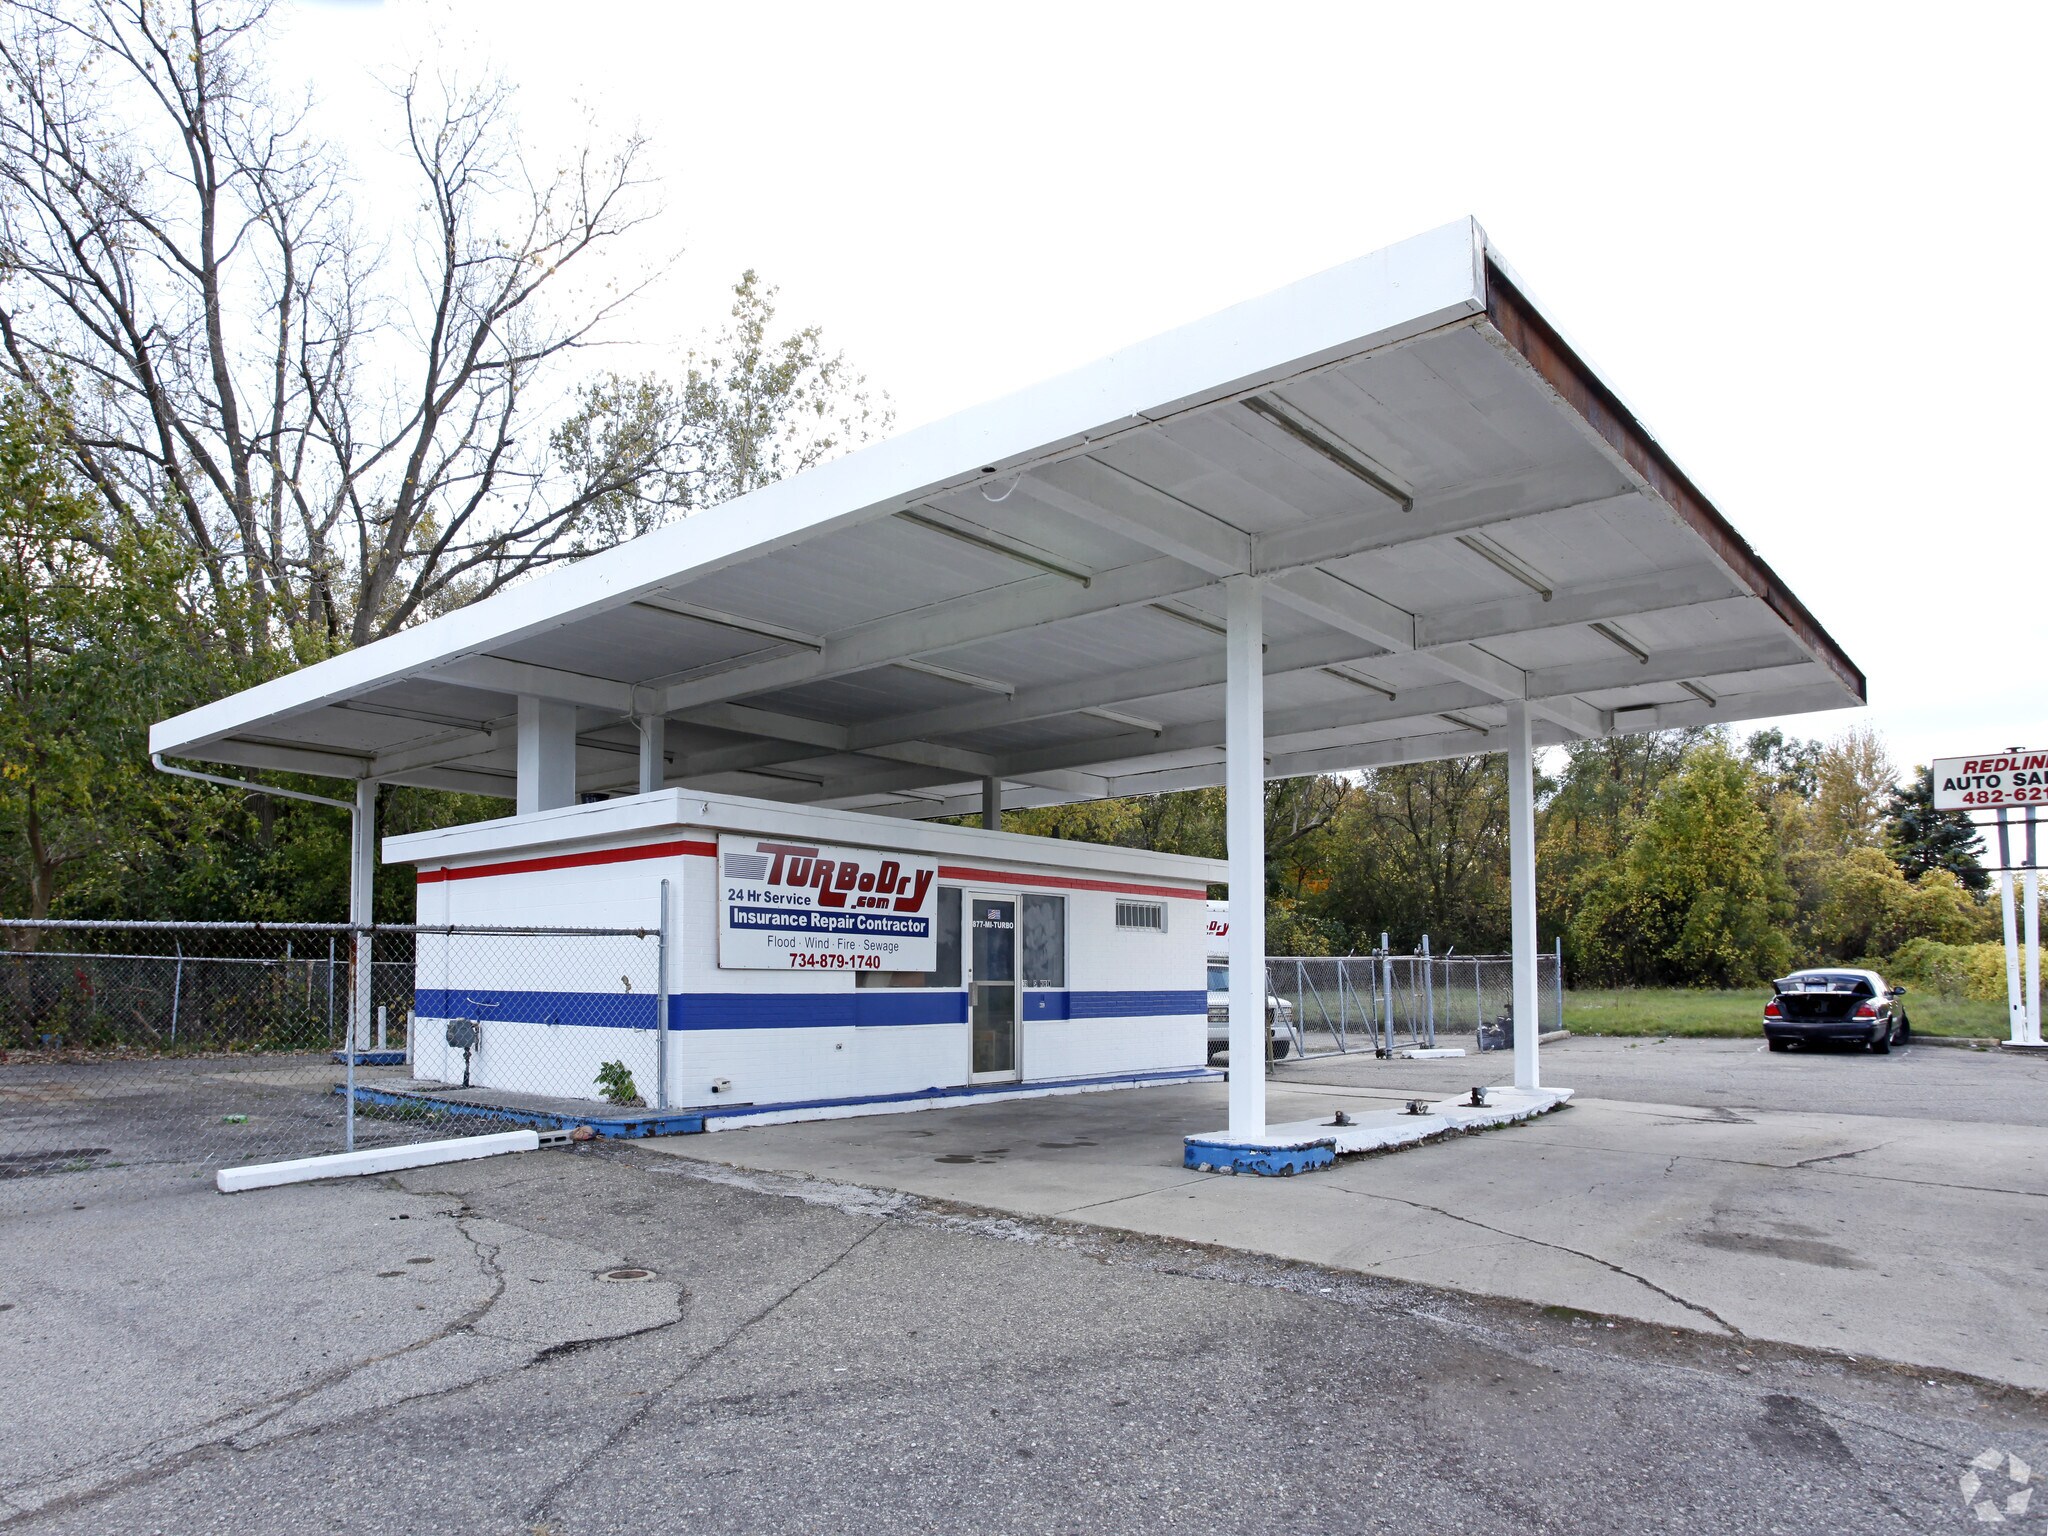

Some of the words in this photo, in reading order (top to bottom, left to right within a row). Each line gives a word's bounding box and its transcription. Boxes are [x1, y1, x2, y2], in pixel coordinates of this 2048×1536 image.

[1963, 755, 2048, 774] REDLIN
[1943, 775, 2001, 791] AUTO
[728, 888, 744, 901] 24
[747, 889, 761, 902] Hr
[764, 891, 811, 905] Service
[851, 896, 889, 909] .com
[734, 905, 807, 927] Insurance
[810, 914, 855, 931] Repair
[857, 915, 926, 933] Contractor
[767, 935, 796, 948] Flood
[804, 937, 830, 949] Wind
[837, 938, 856, 950] Fire
[863, 939, 899, 954] Sewage
[789, 953, 881, 969] 734-879-1740
